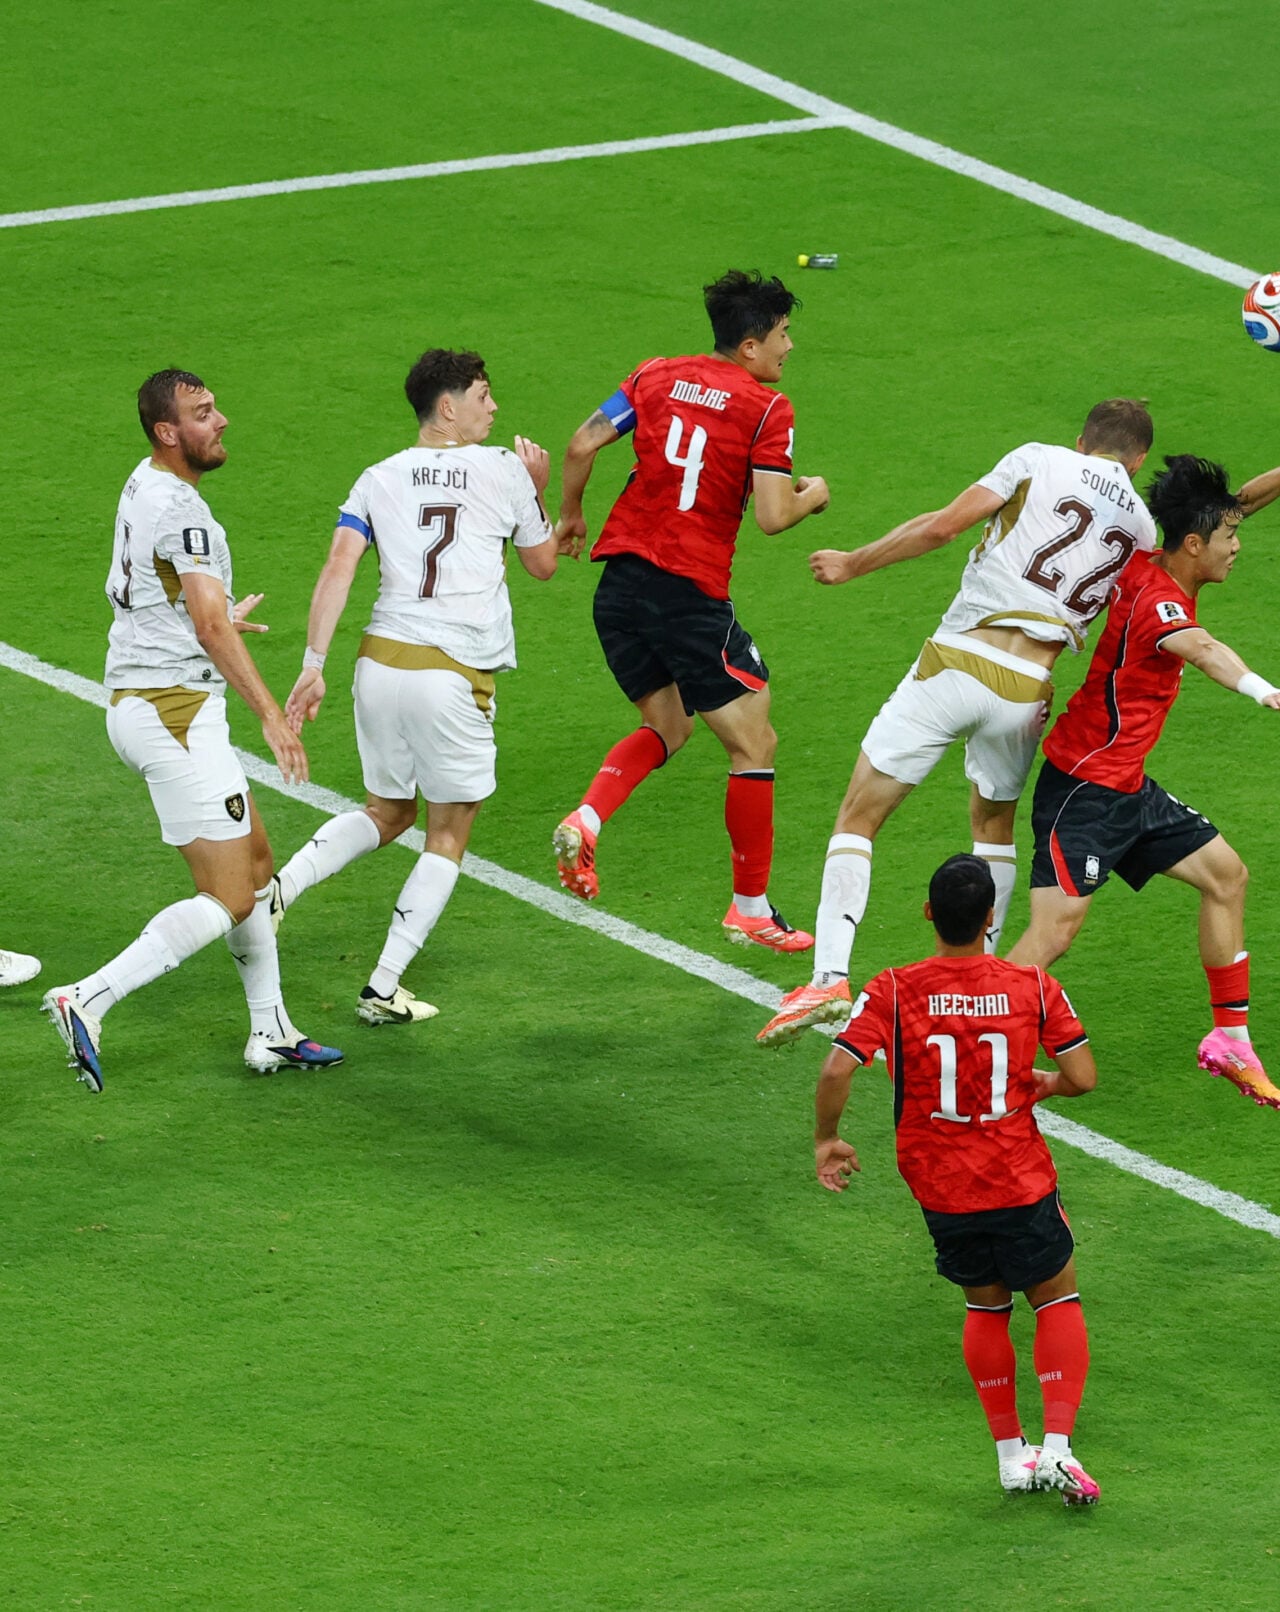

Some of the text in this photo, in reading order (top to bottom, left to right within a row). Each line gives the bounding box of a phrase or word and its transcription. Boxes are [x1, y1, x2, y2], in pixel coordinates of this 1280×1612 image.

[668, 379, 732, 411] MINJAE
[664, 414, 708, 512] 4
[1080, 468, 1136, 514] SOUČEK
[418, 503, 467, 600] 7
[1021, 495, 1138, 617] 22
[927, 993, 1010, 1017] HEECHAN
[926, 1033, 1019, 1123] 11
